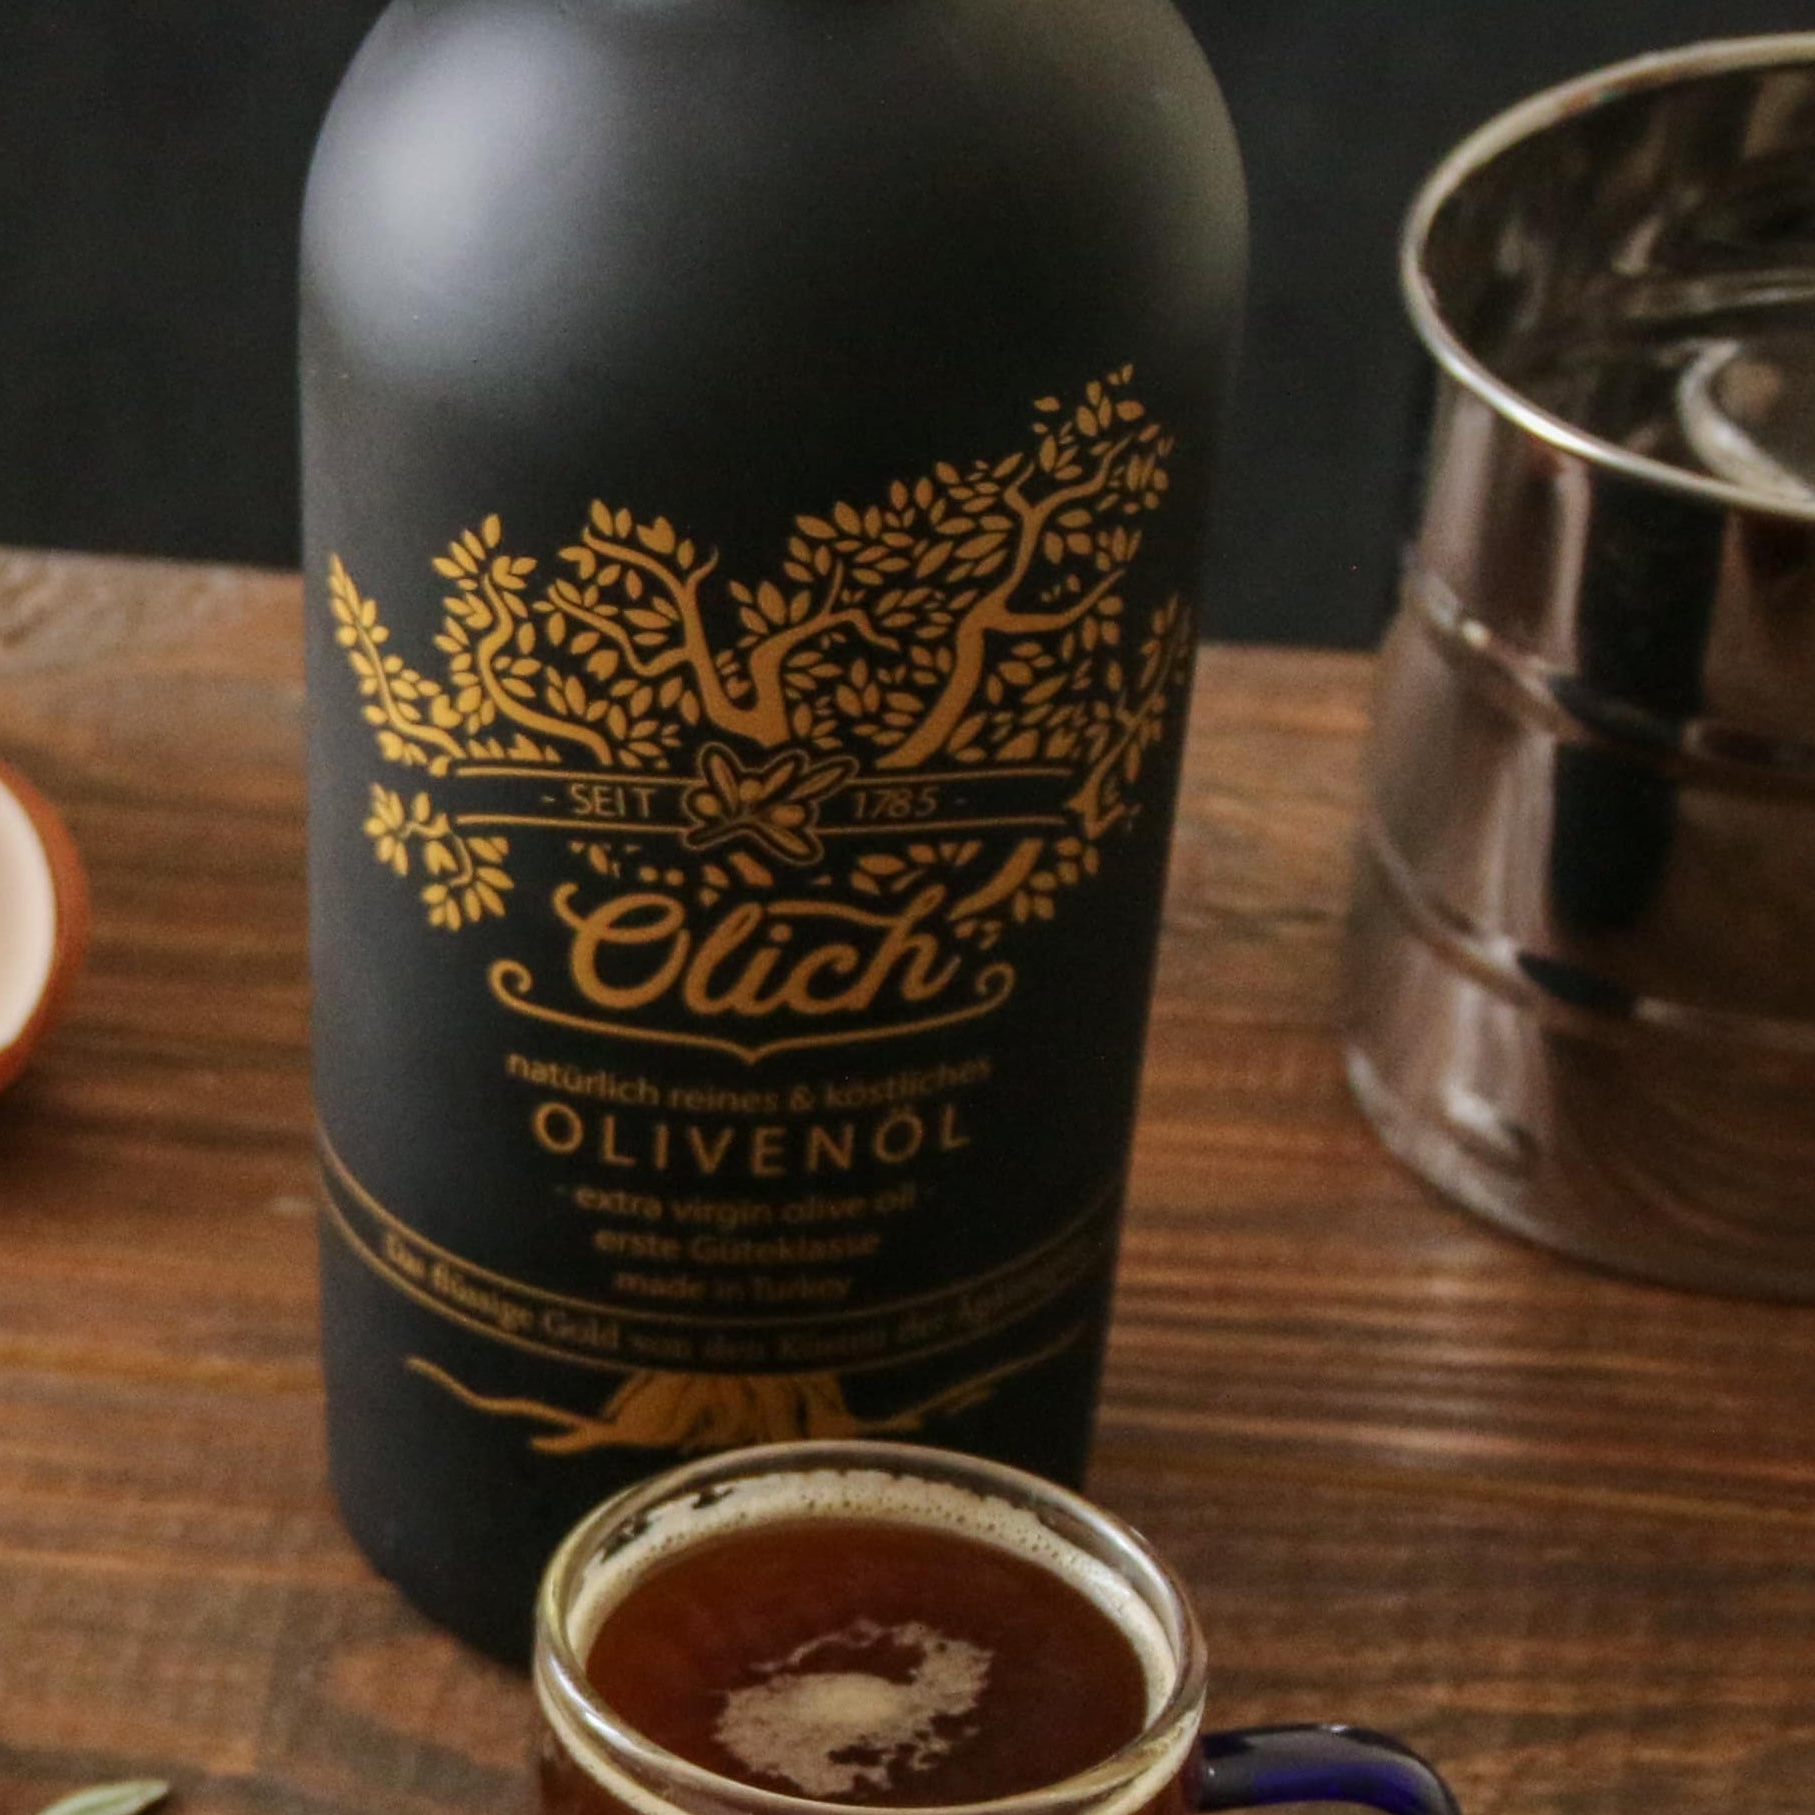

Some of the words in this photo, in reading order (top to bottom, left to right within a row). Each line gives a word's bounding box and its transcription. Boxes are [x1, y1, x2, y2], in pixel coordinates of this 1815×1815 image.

[569, 782, 656, 818] SEIT
[854, 785, 939, 819] 1785
[553, 881, 962, 1017] Olich
[505, 1052, 661, 1106] natürlich
[671, 1084, 779, 1112] reines
[789, 1084, 814, 1113] &
[532, 1100, 972, 1178] OLIVENÖL
[574, 1187, 664, 1221] extra
[671, 1196, 774, 1231] virgin
[780, 1194, 867, 1226] olive
[873, 1182, 917, 1215] oil
[593, 1229, 681, 1260] erste
[612, 1271, 704, 1300] made
[713, 1274, 745, 1301] in
[751, 1273, 853, 1302] Turkey
